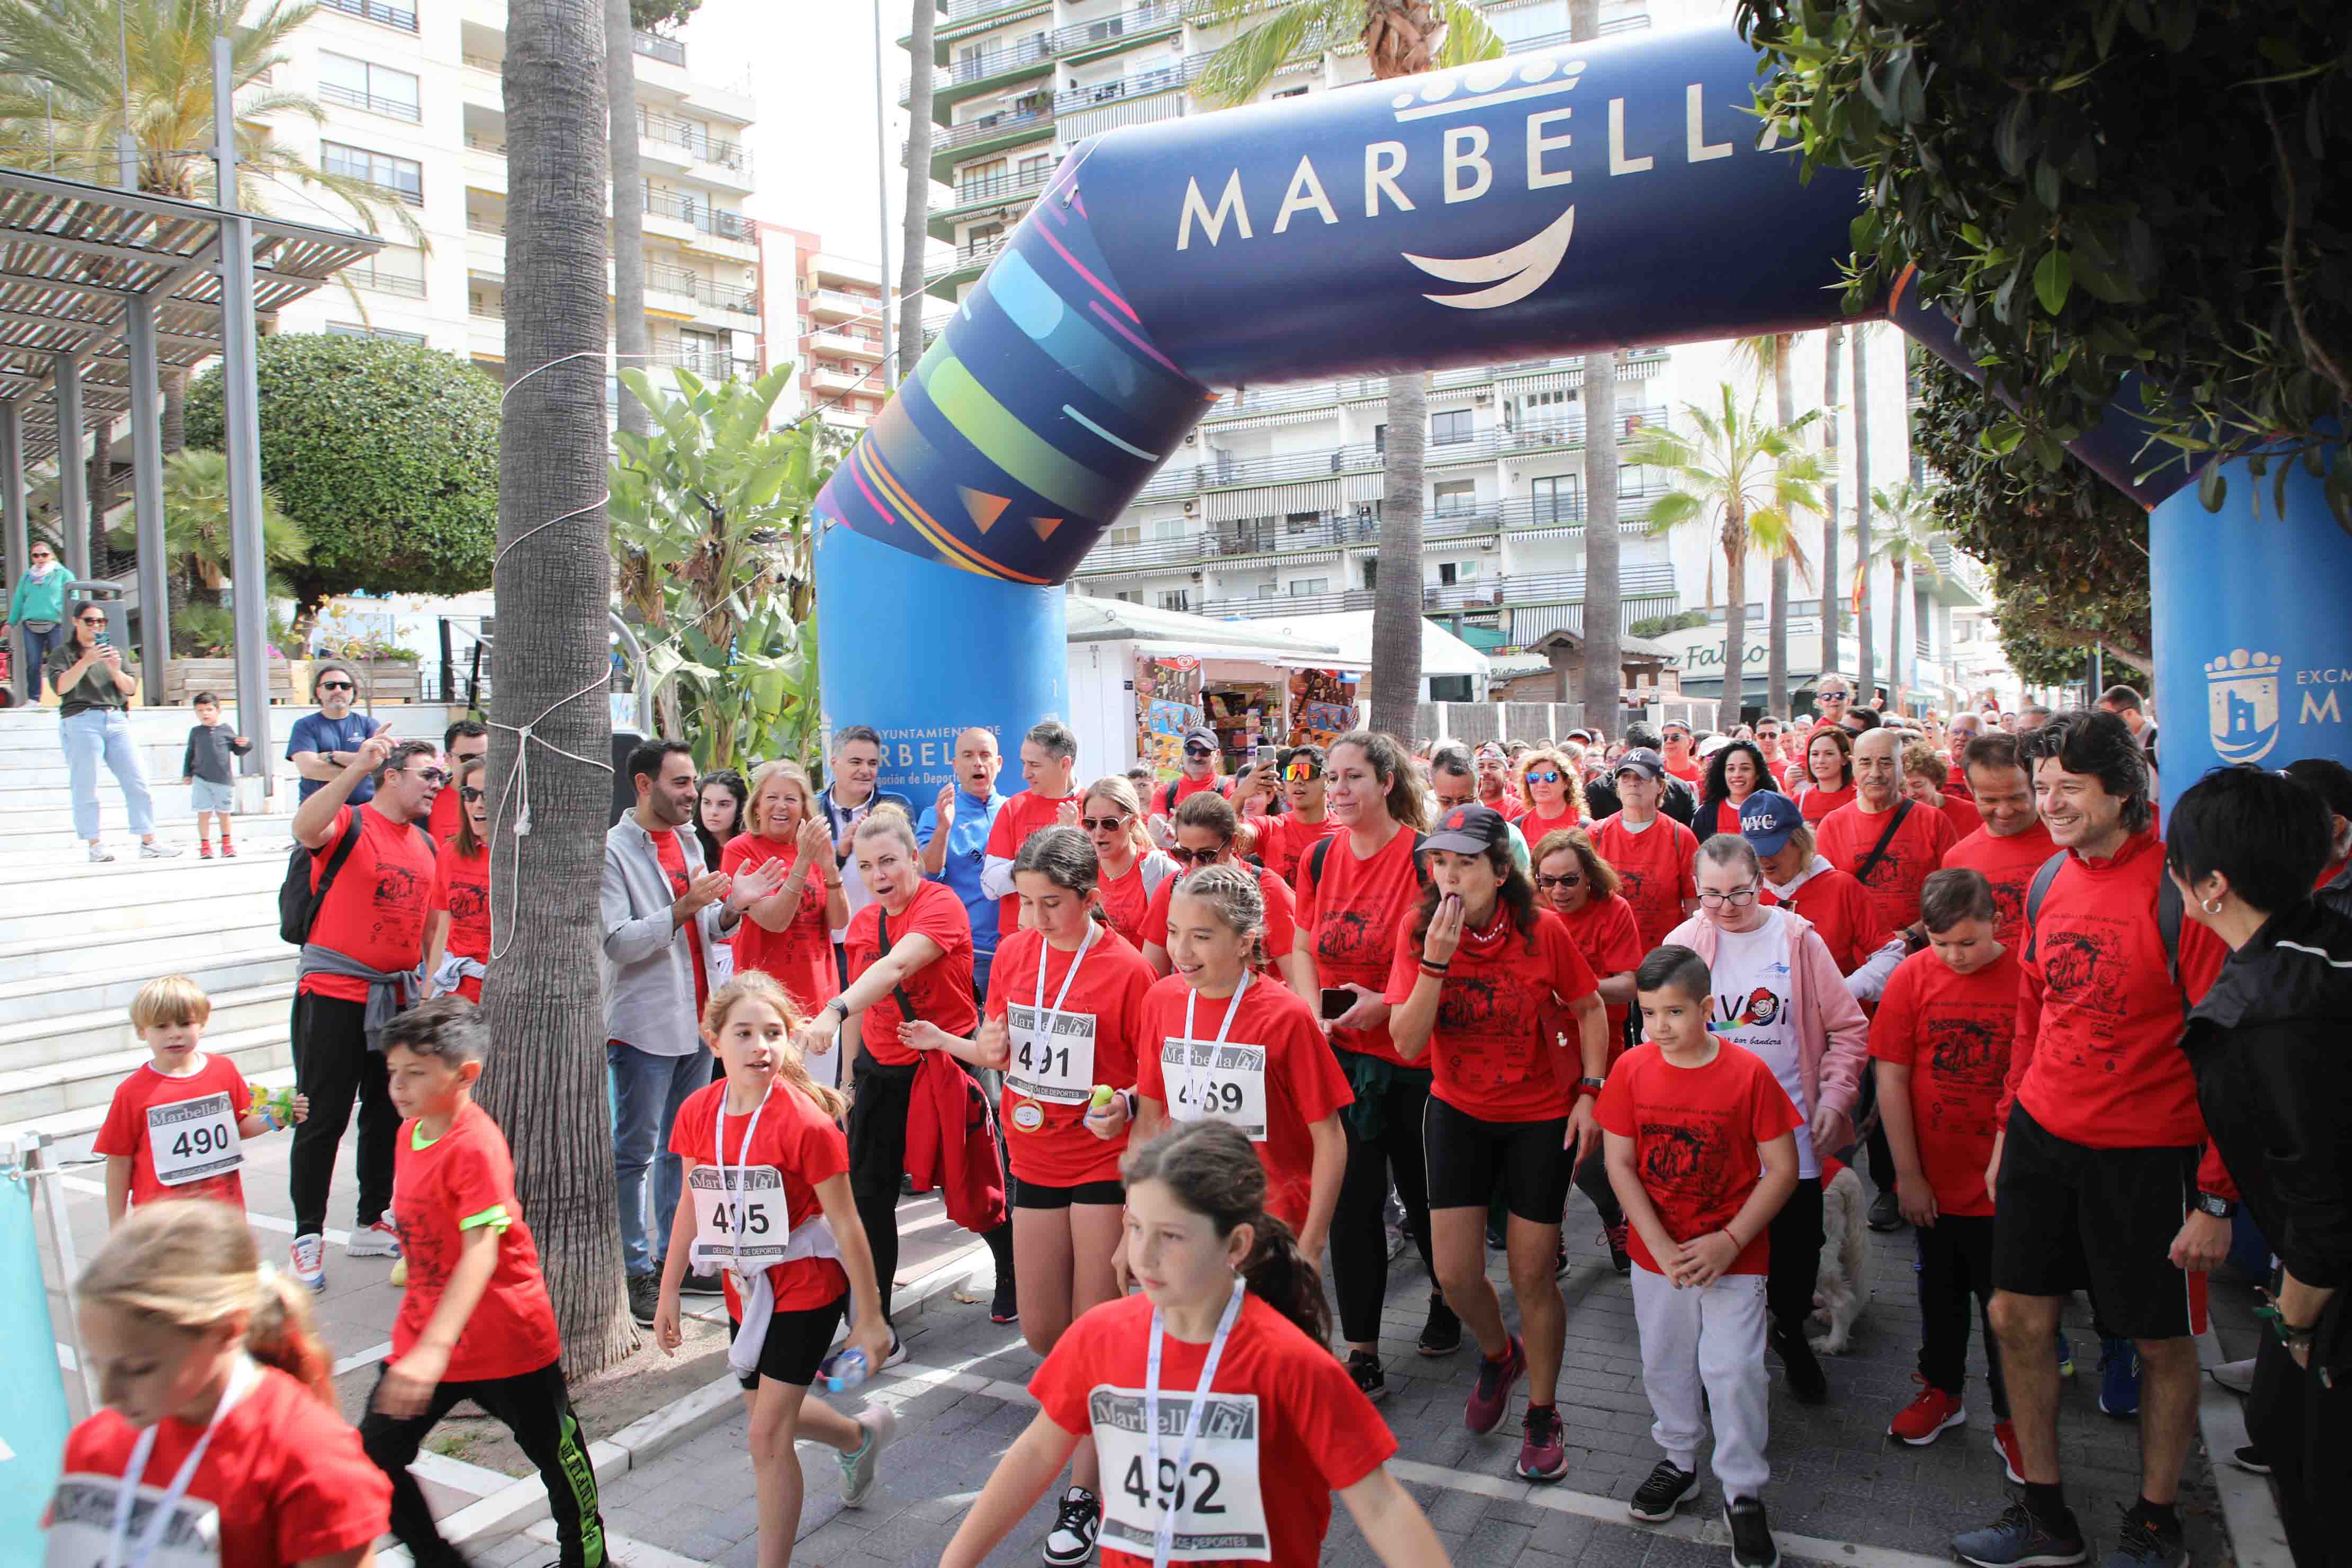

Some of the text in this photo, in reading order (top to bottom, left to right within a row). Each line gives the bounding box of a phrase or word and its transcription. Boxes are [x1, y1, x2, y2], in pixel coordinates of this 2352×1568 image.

[877, 727, 970, 739] AYUNTAMIEN
[908, 771, 919, 784] de
[923, 773, 960, 787] Deport
[1009, 1011, 1066, 1033] Marela
[1018, 1042, 1069, 1077] 491
[1163, 1047, 1232, 1070] Mabela
[151, 1104, 218, 1126] Marbella
[172, 1124, 228, 1158] 490
[693, 1173, 752, 1189] Marela
[1096, 1402, 1205, 1437] Marell
[1124, 1456, 1227, 1513] 492
